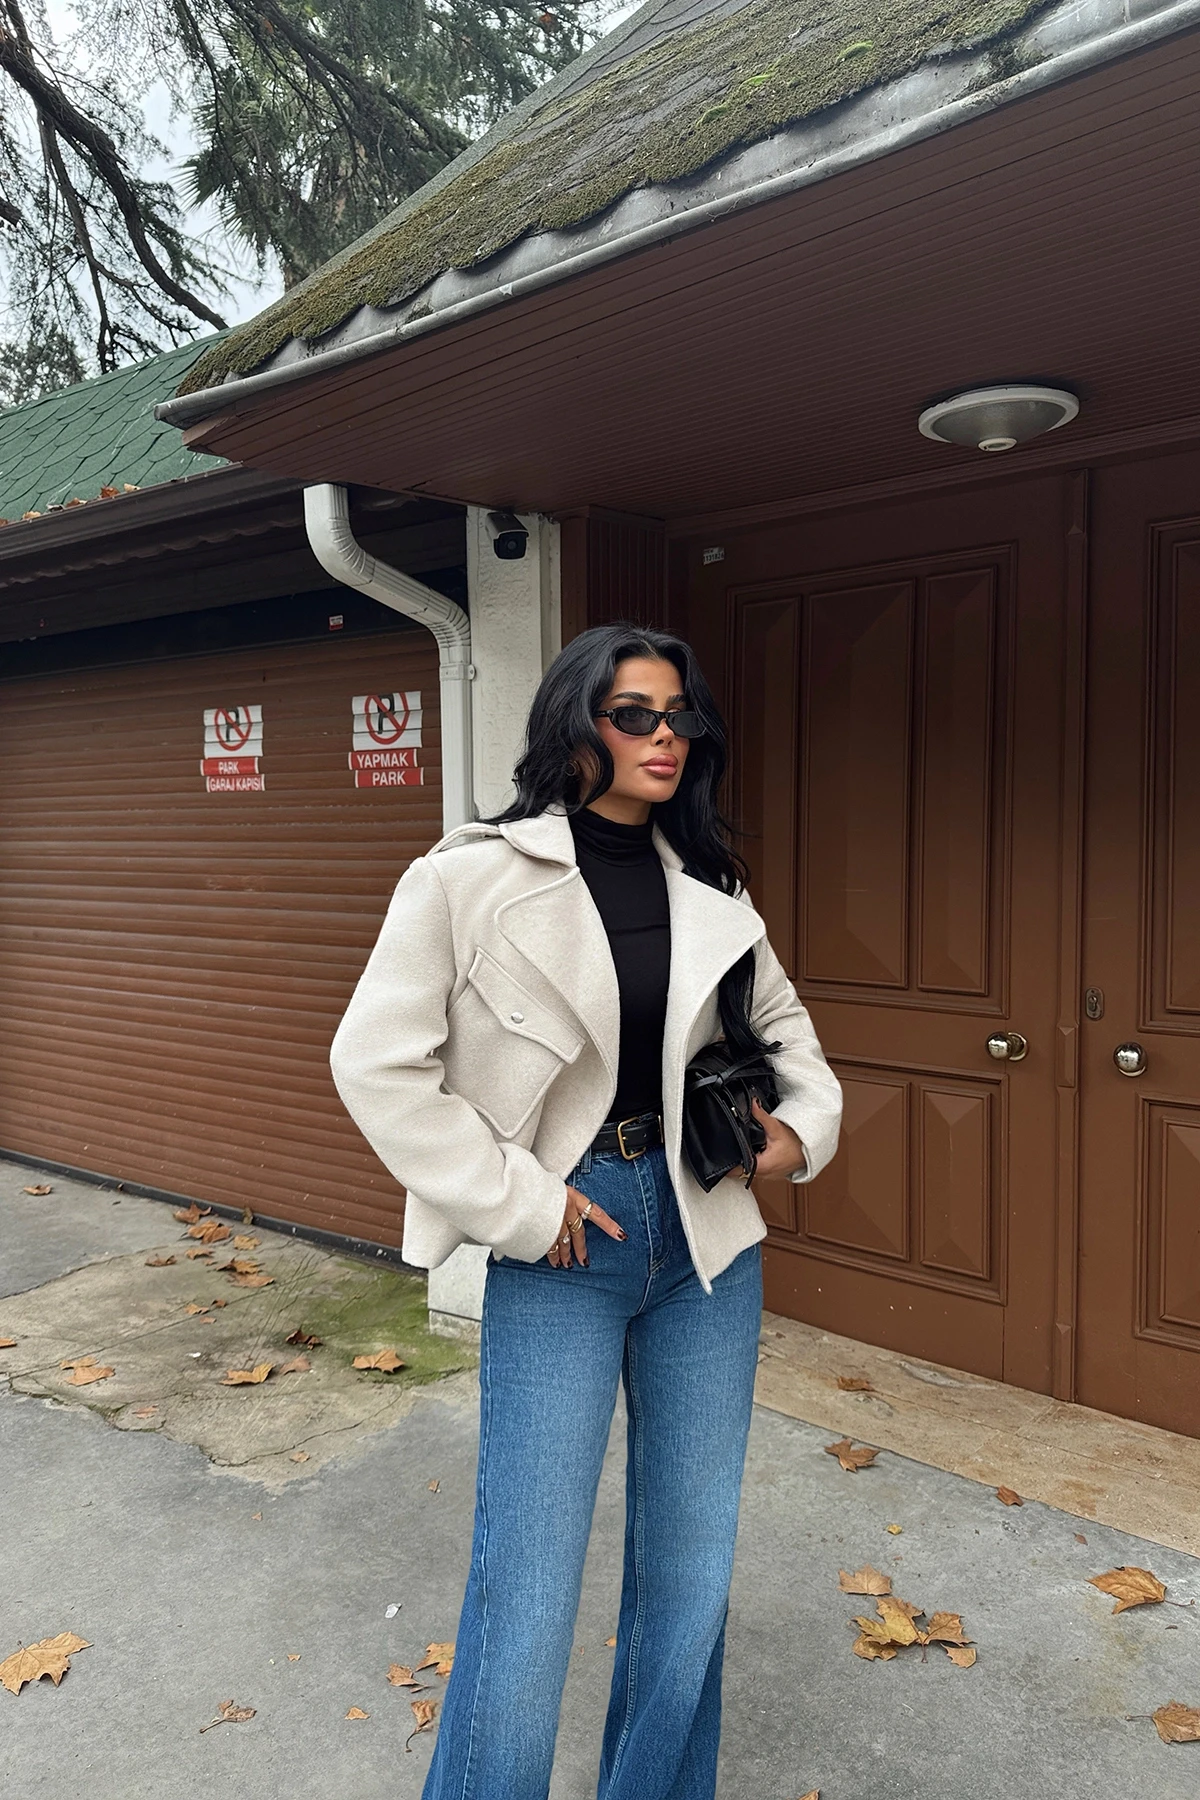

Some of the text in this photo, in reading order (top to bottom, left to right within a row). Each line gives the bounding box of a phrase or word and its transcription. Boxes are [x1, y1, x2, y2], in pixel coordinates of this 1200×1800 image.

[357, 752, 409, 768] YAPMAK
[218, 761, 240, 774] PARK
[209, 777, 236, 791] GARAJ
[372, 771, 406, 786] PARK
